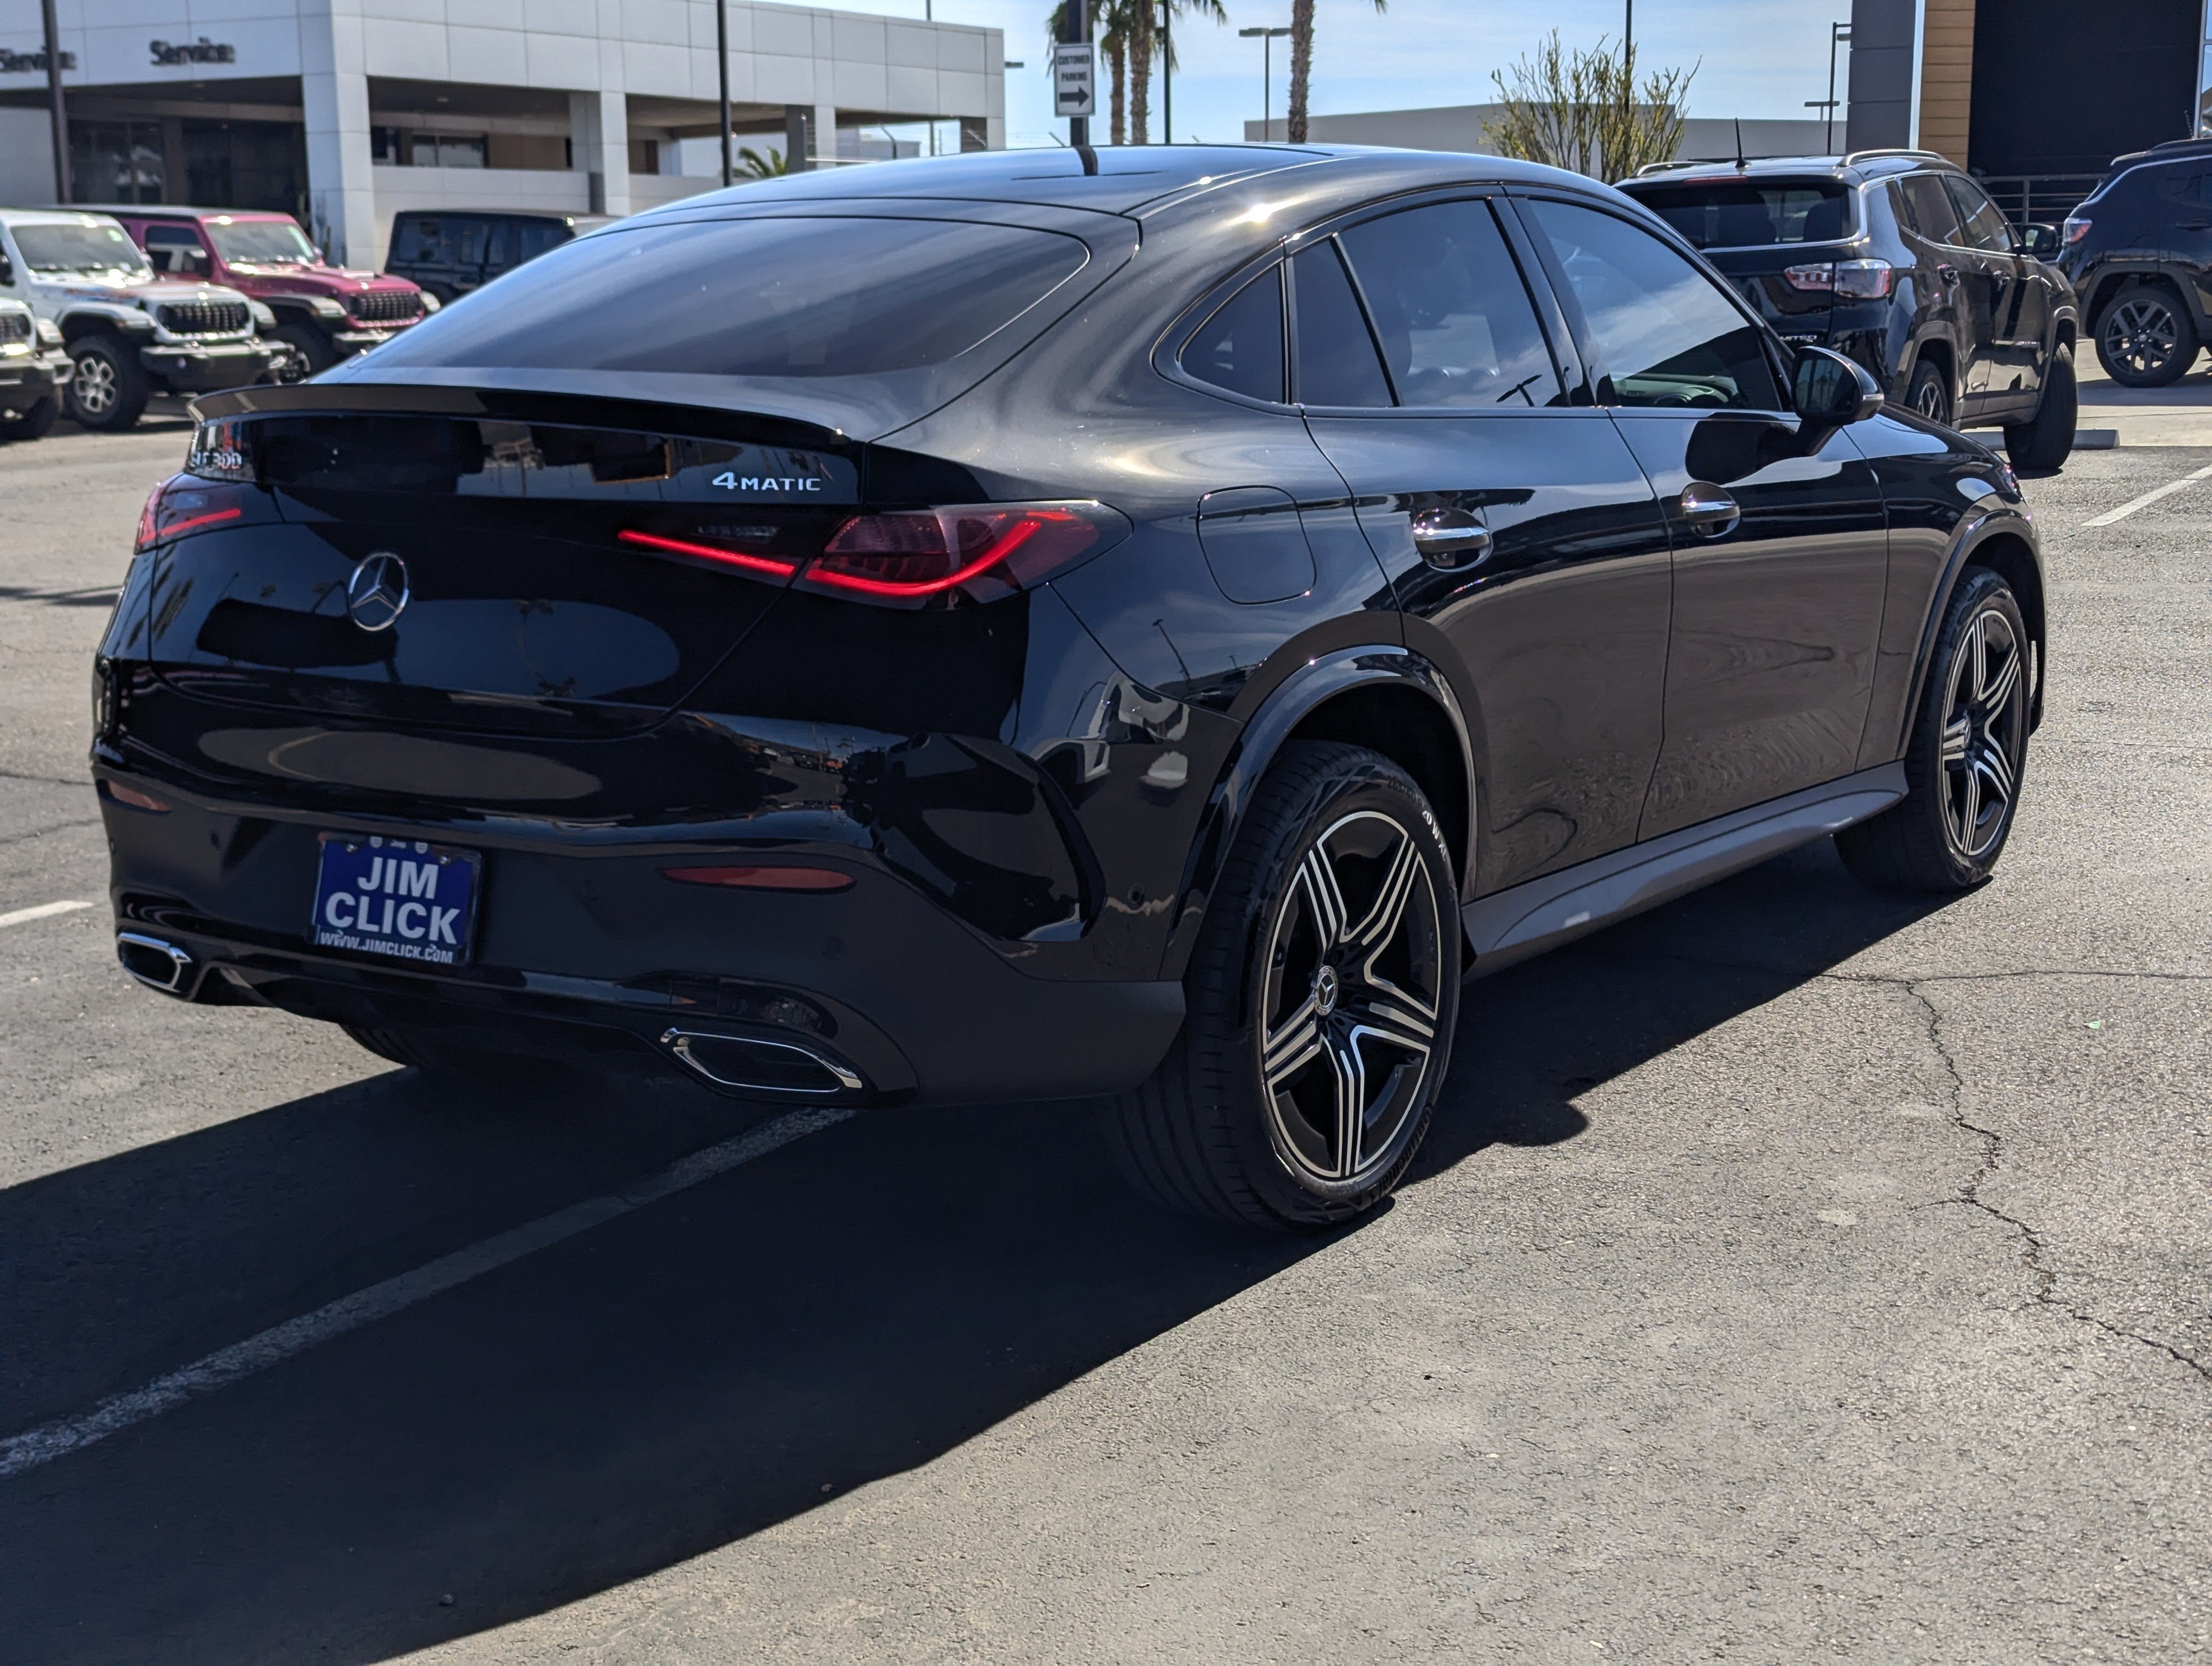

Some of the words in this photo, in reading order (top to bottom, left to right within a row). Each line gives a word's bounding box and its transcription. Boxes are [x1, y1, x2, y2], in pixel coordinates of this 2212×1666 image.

[0, 46, 76, 73] Serve
[149, 36, 235, 66] Service
[1058, 55, 1090, 65] CUSTOMER
[1062, 72, 1087, 82] PARKING
[212, 452, 242, 470] 300
[712, 471, 822, 491] 4MATIC
[356, 857, 439, 899] JIM
[325, 892, 461, 944] CLICK
[320, 931, 453, 964] WWW.JIMCLICK.COM
